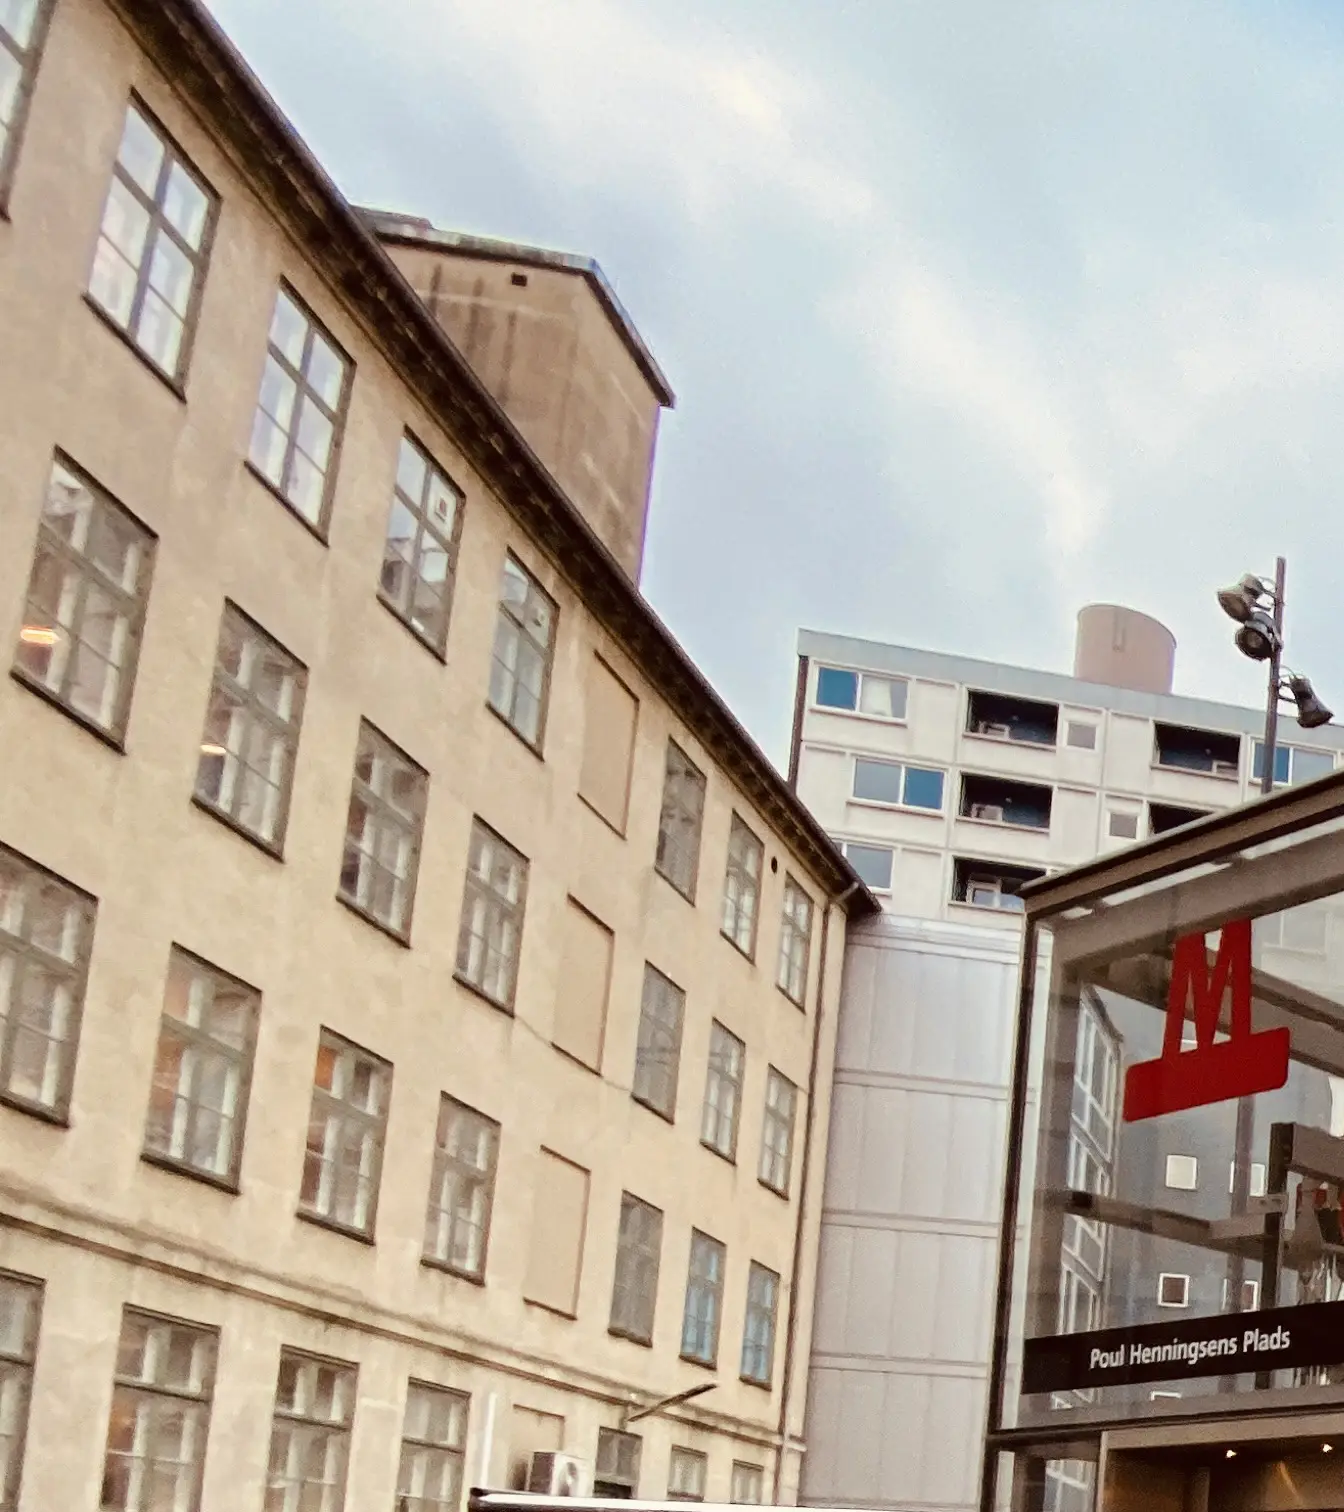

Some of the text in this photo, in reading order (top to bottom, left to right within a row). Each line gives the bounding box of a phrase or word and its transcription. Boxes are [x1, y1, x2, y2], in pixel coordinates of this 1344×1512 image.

[1089, 1325, 1291, 1370] Poul Henningsens Plads
